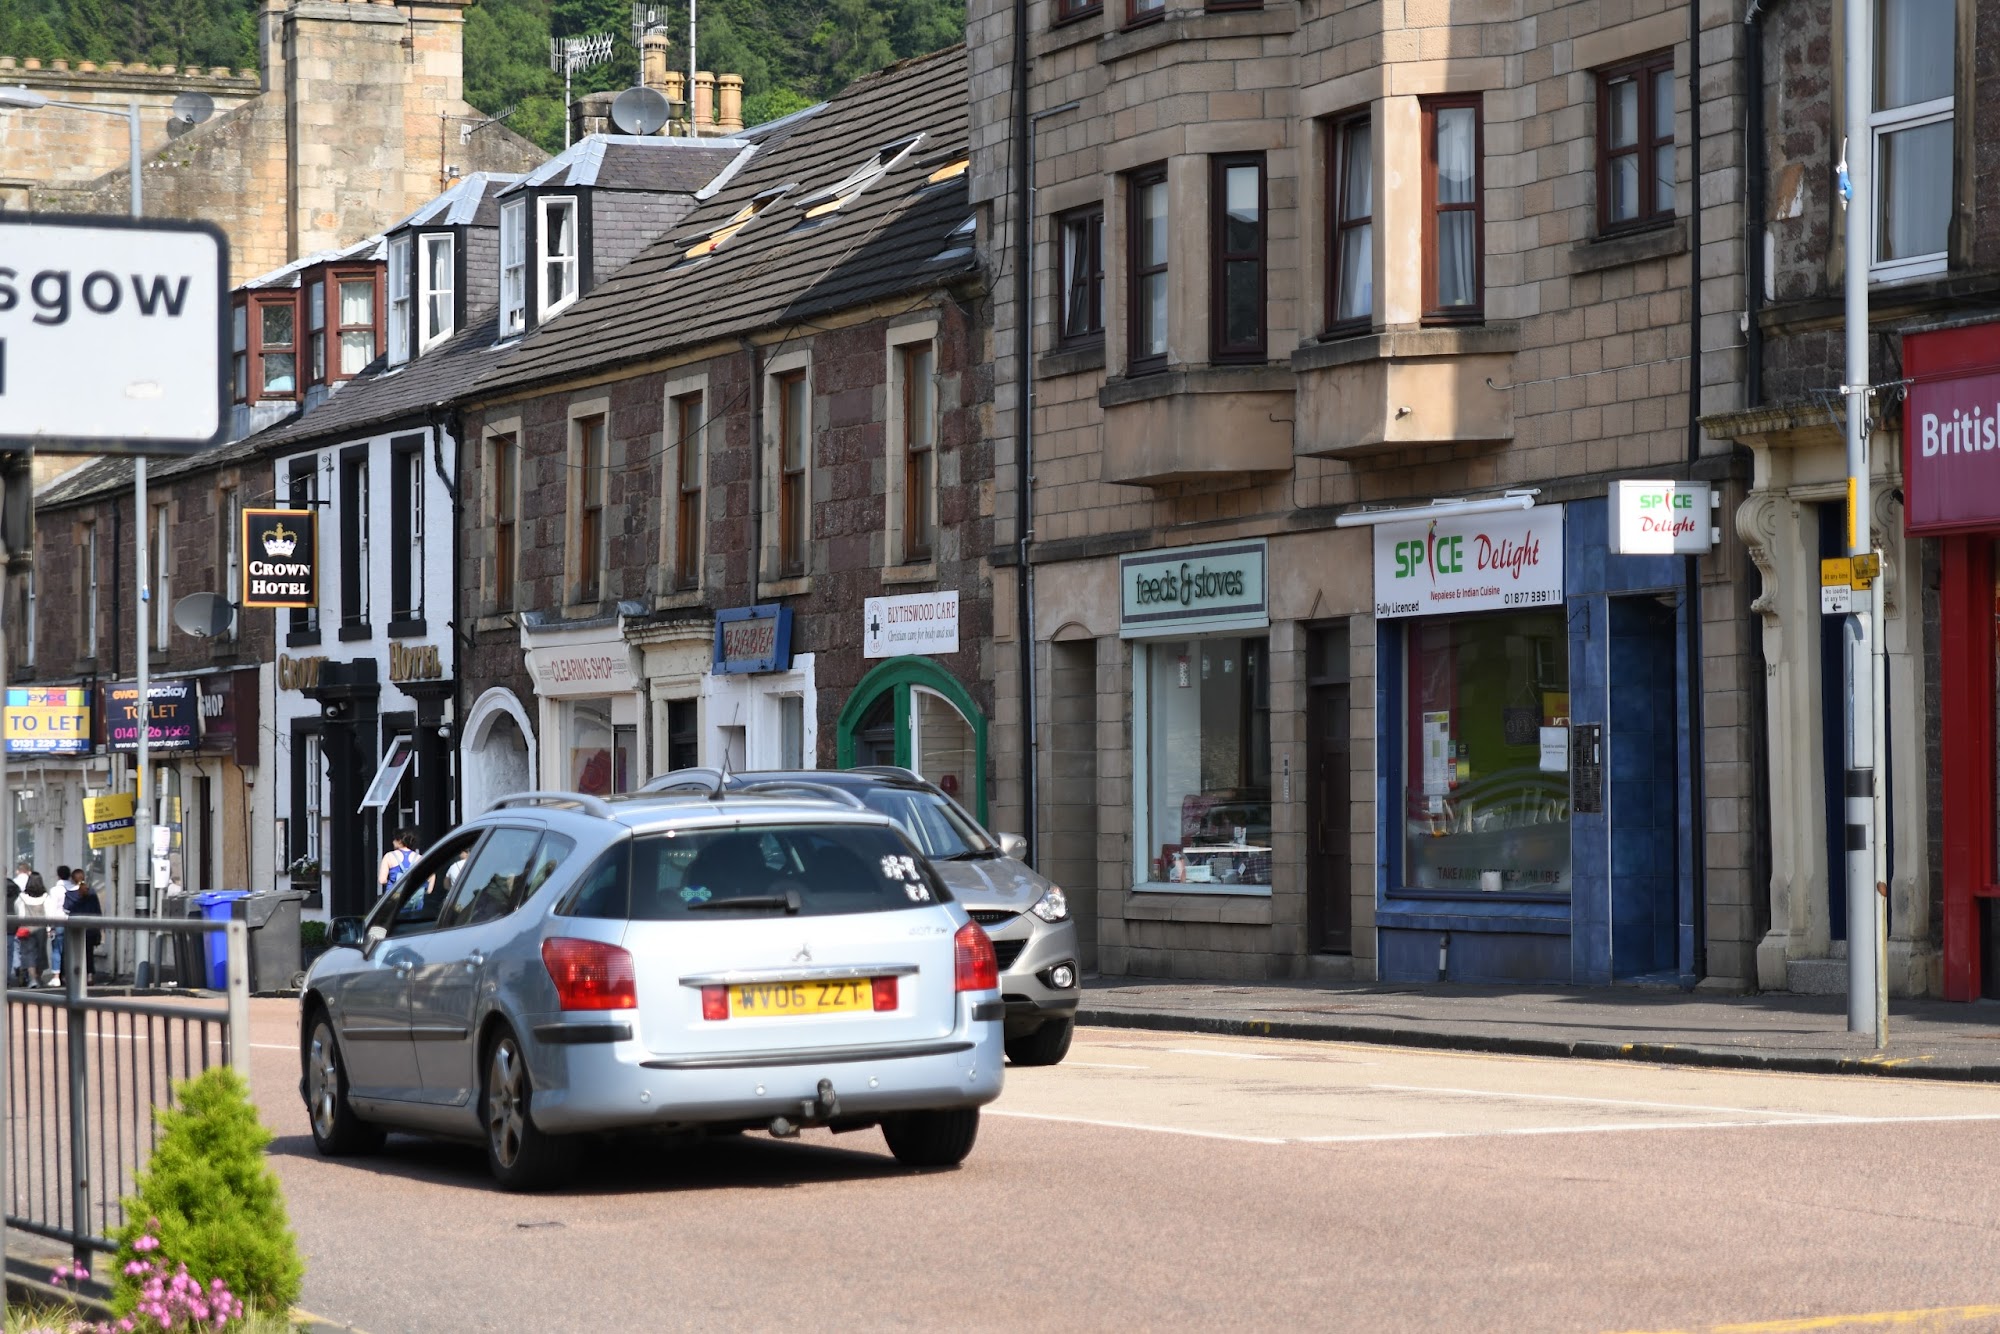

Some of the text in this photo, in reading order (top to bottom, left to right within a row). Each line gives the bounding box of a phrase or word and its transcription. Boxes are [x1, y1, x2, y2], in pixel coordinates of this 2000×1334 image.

[1640, 491, 1692, 512] SPICE
[1638, 516, 1696, 537] Delight
[1395, 526, 1540, 586] SPICE Delight
[249, 561, 311, 576] CROWN
[251, 580, 310, 595] HOTEL
[1136, 562, 1244, 606] feeds & stoves
[1832, 587, 1849, 596] loading
[1431, 586, 1500, 602] Nepalese & Indian Cuisine
[1504, 592, 1529, 605] 01877
[888, 601, 956, 624] BLYTHSWOOD CARE
[1376, 600, 1420, 616] Fully Licenced
[389, 641, 443, 682] HOTEL
[551, 658, 592, 683] CLEARING
[590, 656, 613, 680] SHOP
[112, 689, 139, 700] ewa
[151, 704, 178, 718] LET
[200, 694, 224, 717] SHOP
[10, 715, 84, 731] TO LET
[114, 724, 191, 739] 0141 26 1662
[92, 819, 129, 831] FOR SALE
[740, 981, 862, 1011] WV06 ZZT
